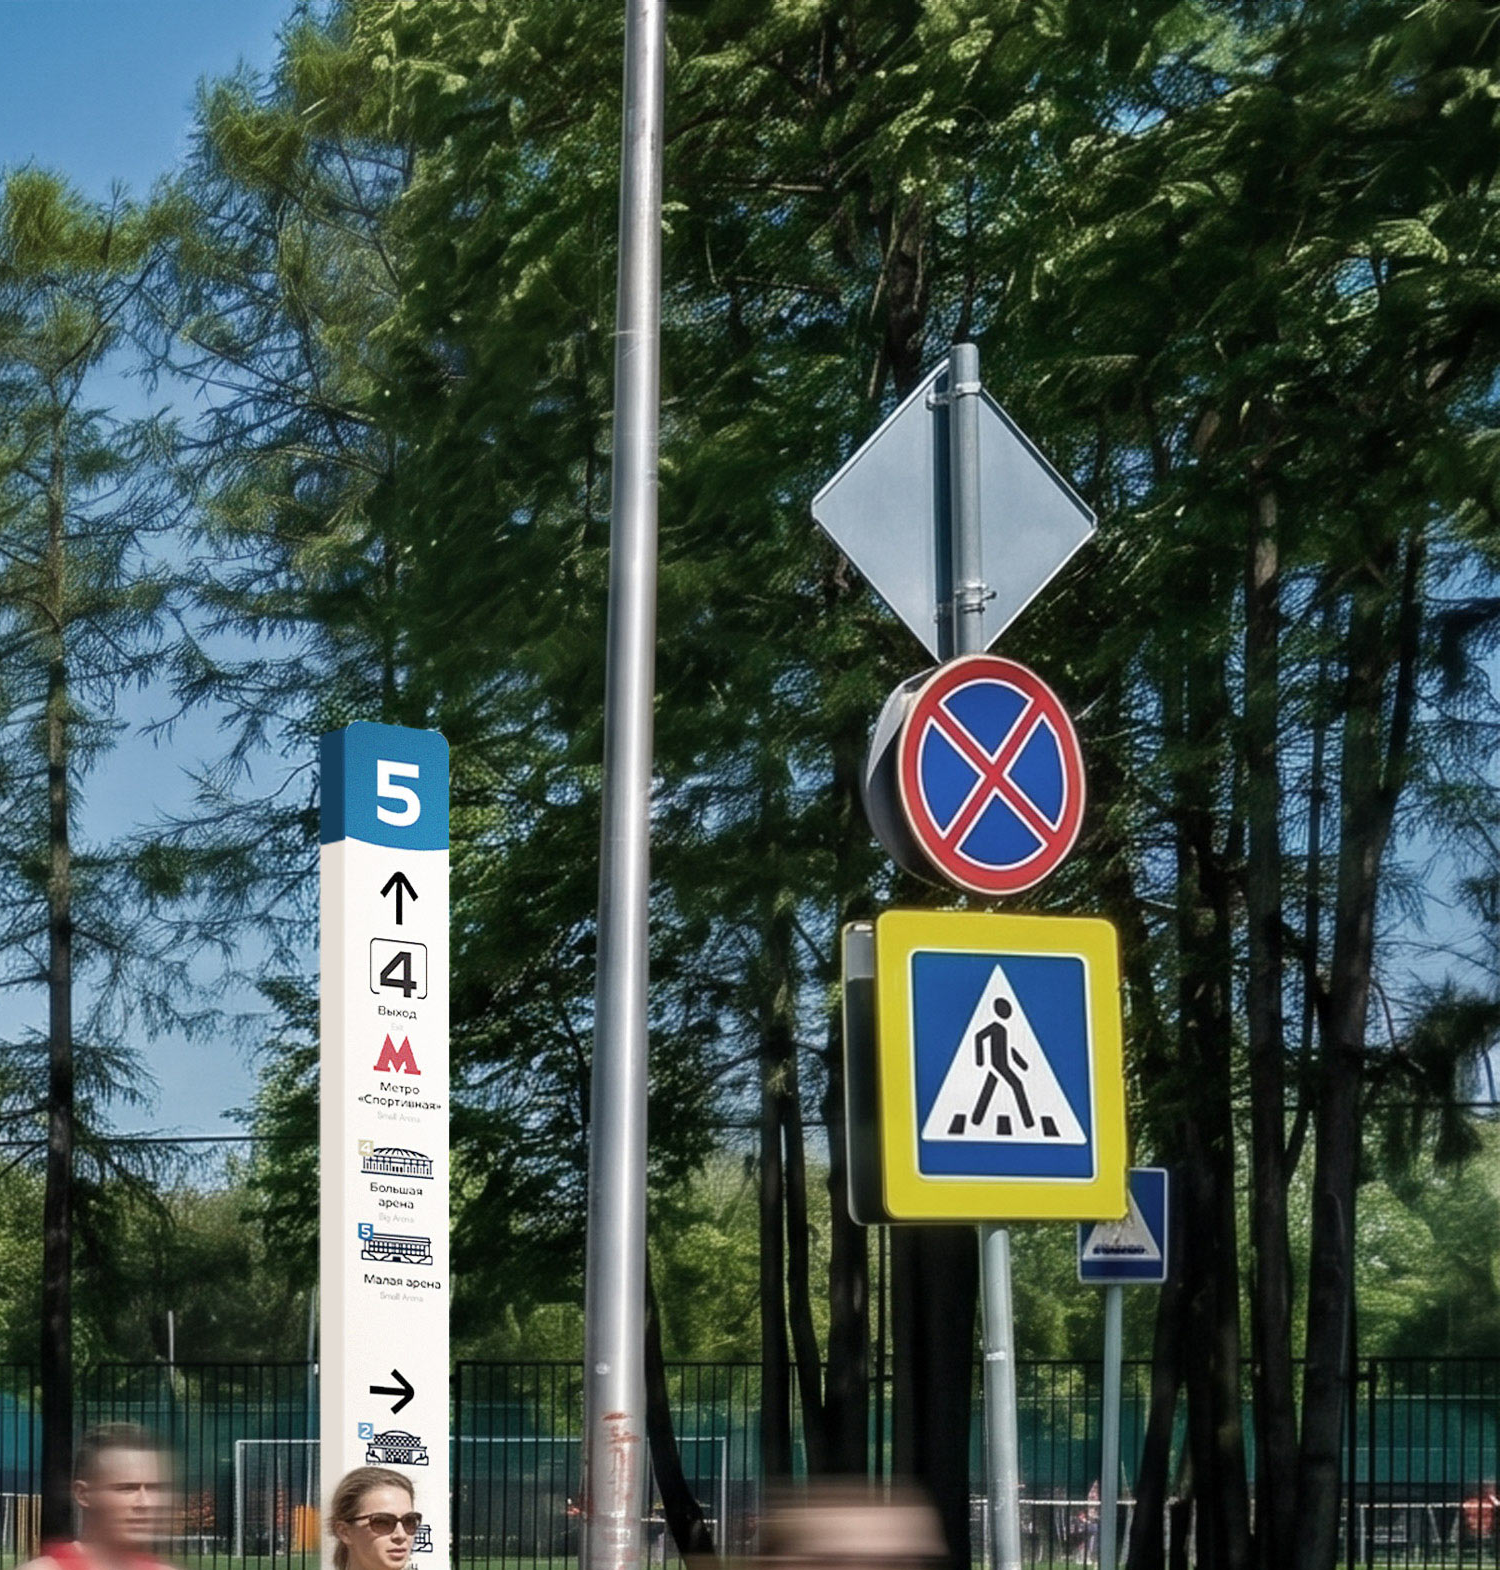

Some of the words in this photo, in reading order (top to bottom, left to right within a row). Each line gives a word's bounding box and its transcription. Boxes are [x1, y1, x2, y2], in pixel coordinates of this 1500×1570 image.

[377, 759, 421, 827] 5
[380, 951, 417, 998] 4
[378, 1005, 417, 1020] Выход
[380, 1082, 420, 1096] Метро
[370, 1181, 423, 1196] Большая
[378, 1199, 414, 1210] арена
[361, 1224, 371, 1238] 5
[364, 1273, 403, 1286] Малая
[406, 1279, 441, 1290] арена
[361, 1424, 371, 1438] 2
